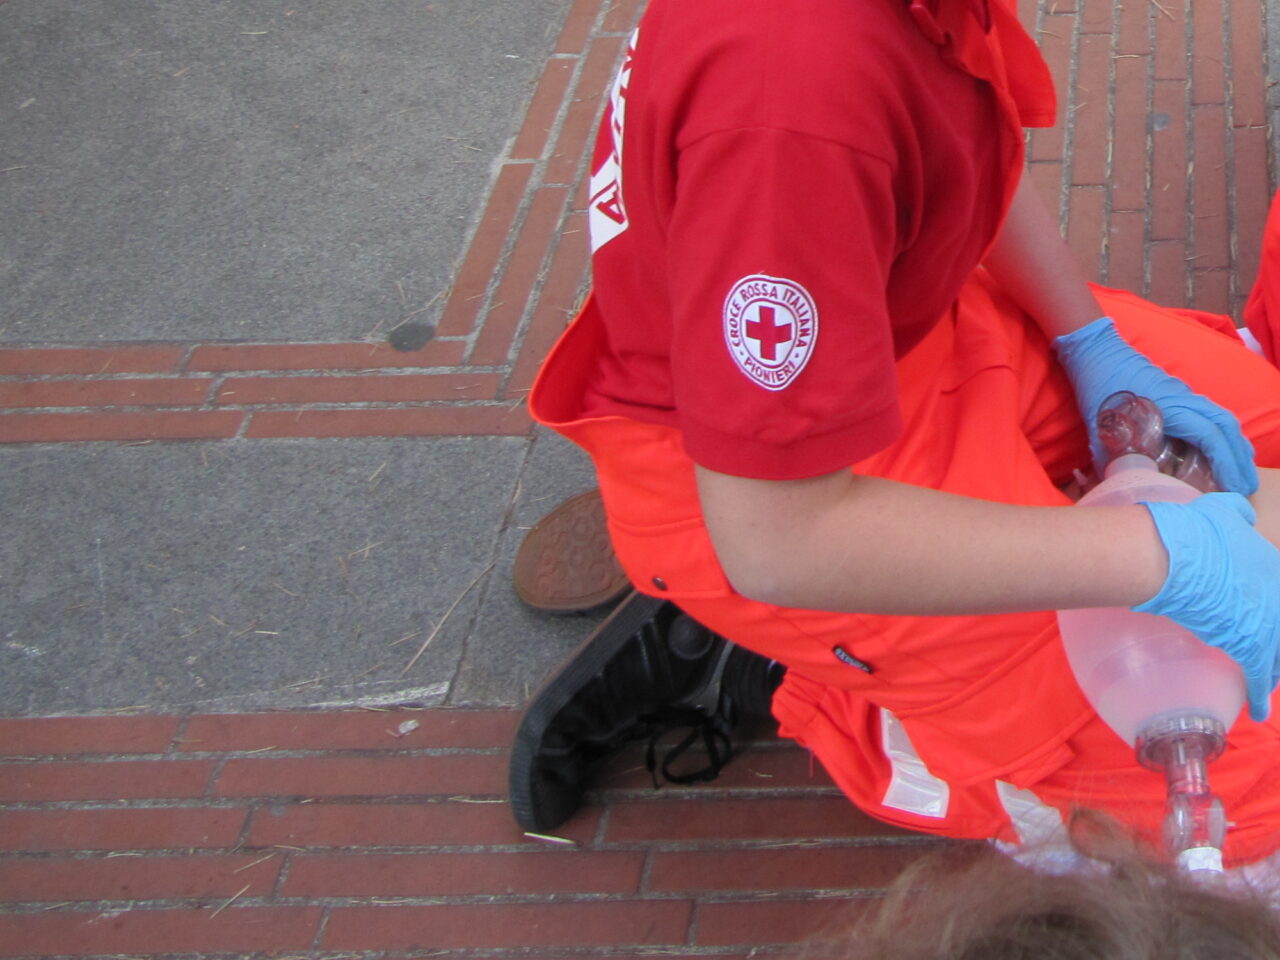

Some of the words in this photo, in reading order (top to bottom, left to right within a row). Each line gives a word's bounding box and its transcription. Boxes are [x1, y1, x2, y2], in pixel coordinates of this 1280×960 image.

[730, 299, 741, 347] CROCE
[740, 283, 778, 301] ROSSA
[783, 288, 810, 347] ITALIANA
[744, 357, 795, 383] PIONIERI
